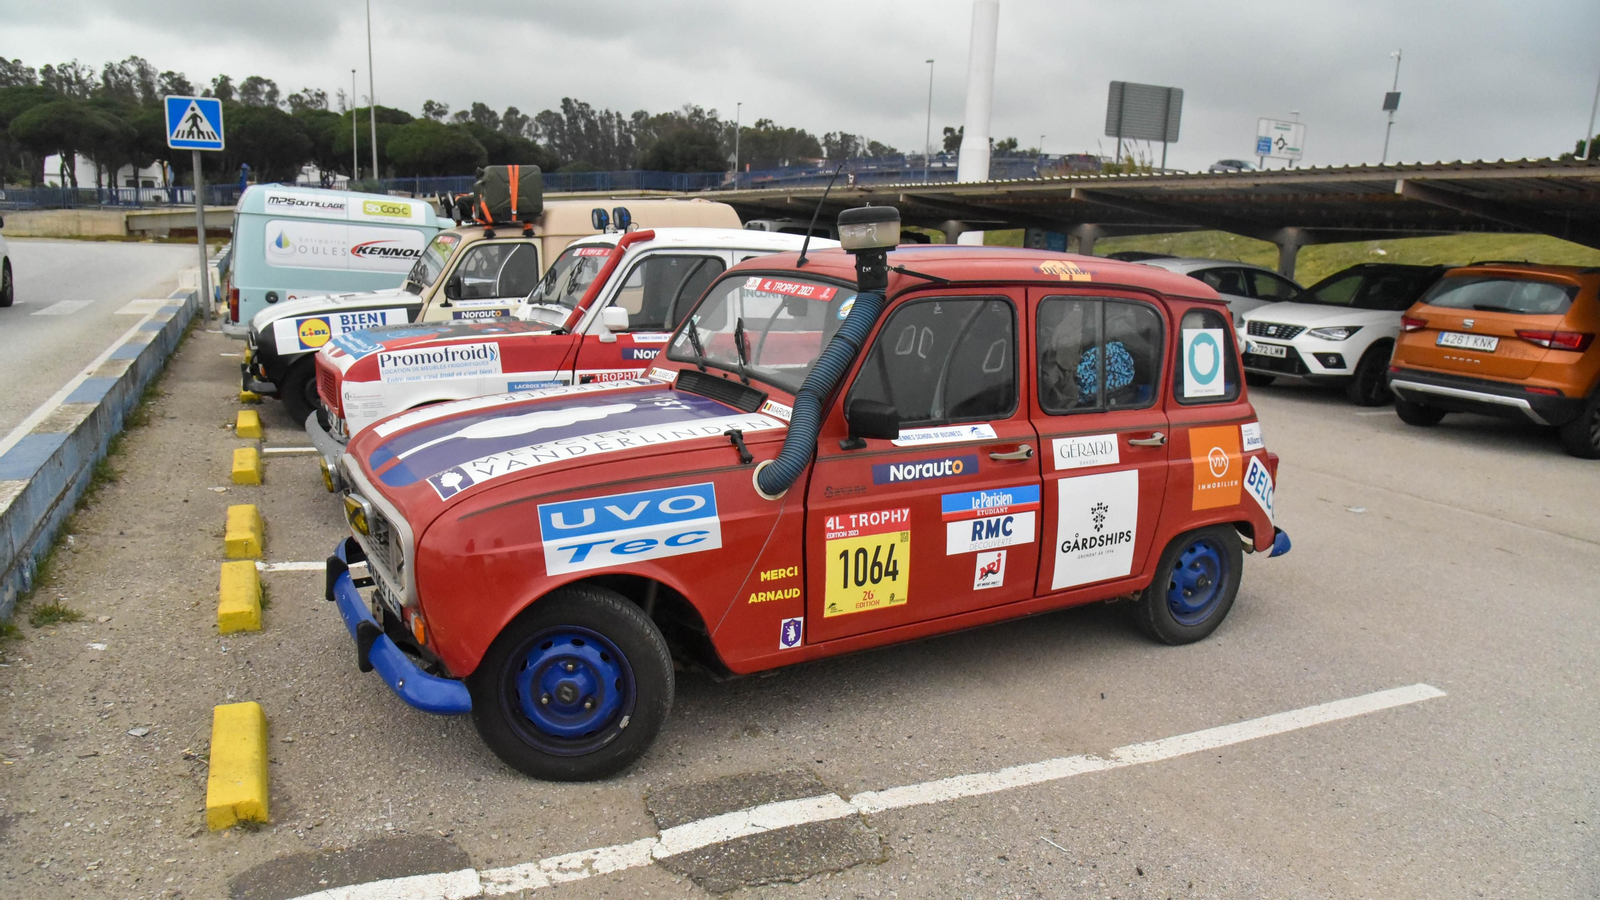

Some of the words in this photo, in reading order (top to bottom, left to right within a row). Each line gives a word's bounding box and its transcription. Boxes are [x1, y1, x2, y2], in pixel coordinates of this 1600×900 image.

[298, 245, 346, 256] OULES
[356, 246, 422, 257] KENNOL
[340, 312, 378, 325] BIEN
[462, 310, 502, 318] Norauto
[1444, 333, 1469, 345] 4261
[1472, 338, 1494, 348] KNK
[380, 344, 488, 367] Promofroid
[634, 349, 660, 359] Nor
[596, 371, 637, 382] TROPHY
[471, 429, 636, 467] MERCIER
[476, 419, 772, 476] VANDERLINDEN
[1060, 440, 1113, 459] GÉRARD
[890, 459, 964, 481] Norauto
[1198, 480, 1238, 490] IMMOBILIEN
[972, 496, 980, 509] Le
[980, 492, 1012, 508] Parisien
[551, 495, 706, 530] UVO
[826, 517, 844, 530] 4L
[850, 508, 909, 527] TROPHY
[971, 516, 1014, 541] RMC
[969, 538, 1013, 550] DÉCOUVERTE
[1061, 530, 1132, 553] GÅRDSHIPS
[760, 566, 798, 582] MERCI
[839, 544, 898, 588] 1064
[748, 588, 800, 604] ARNAUD
